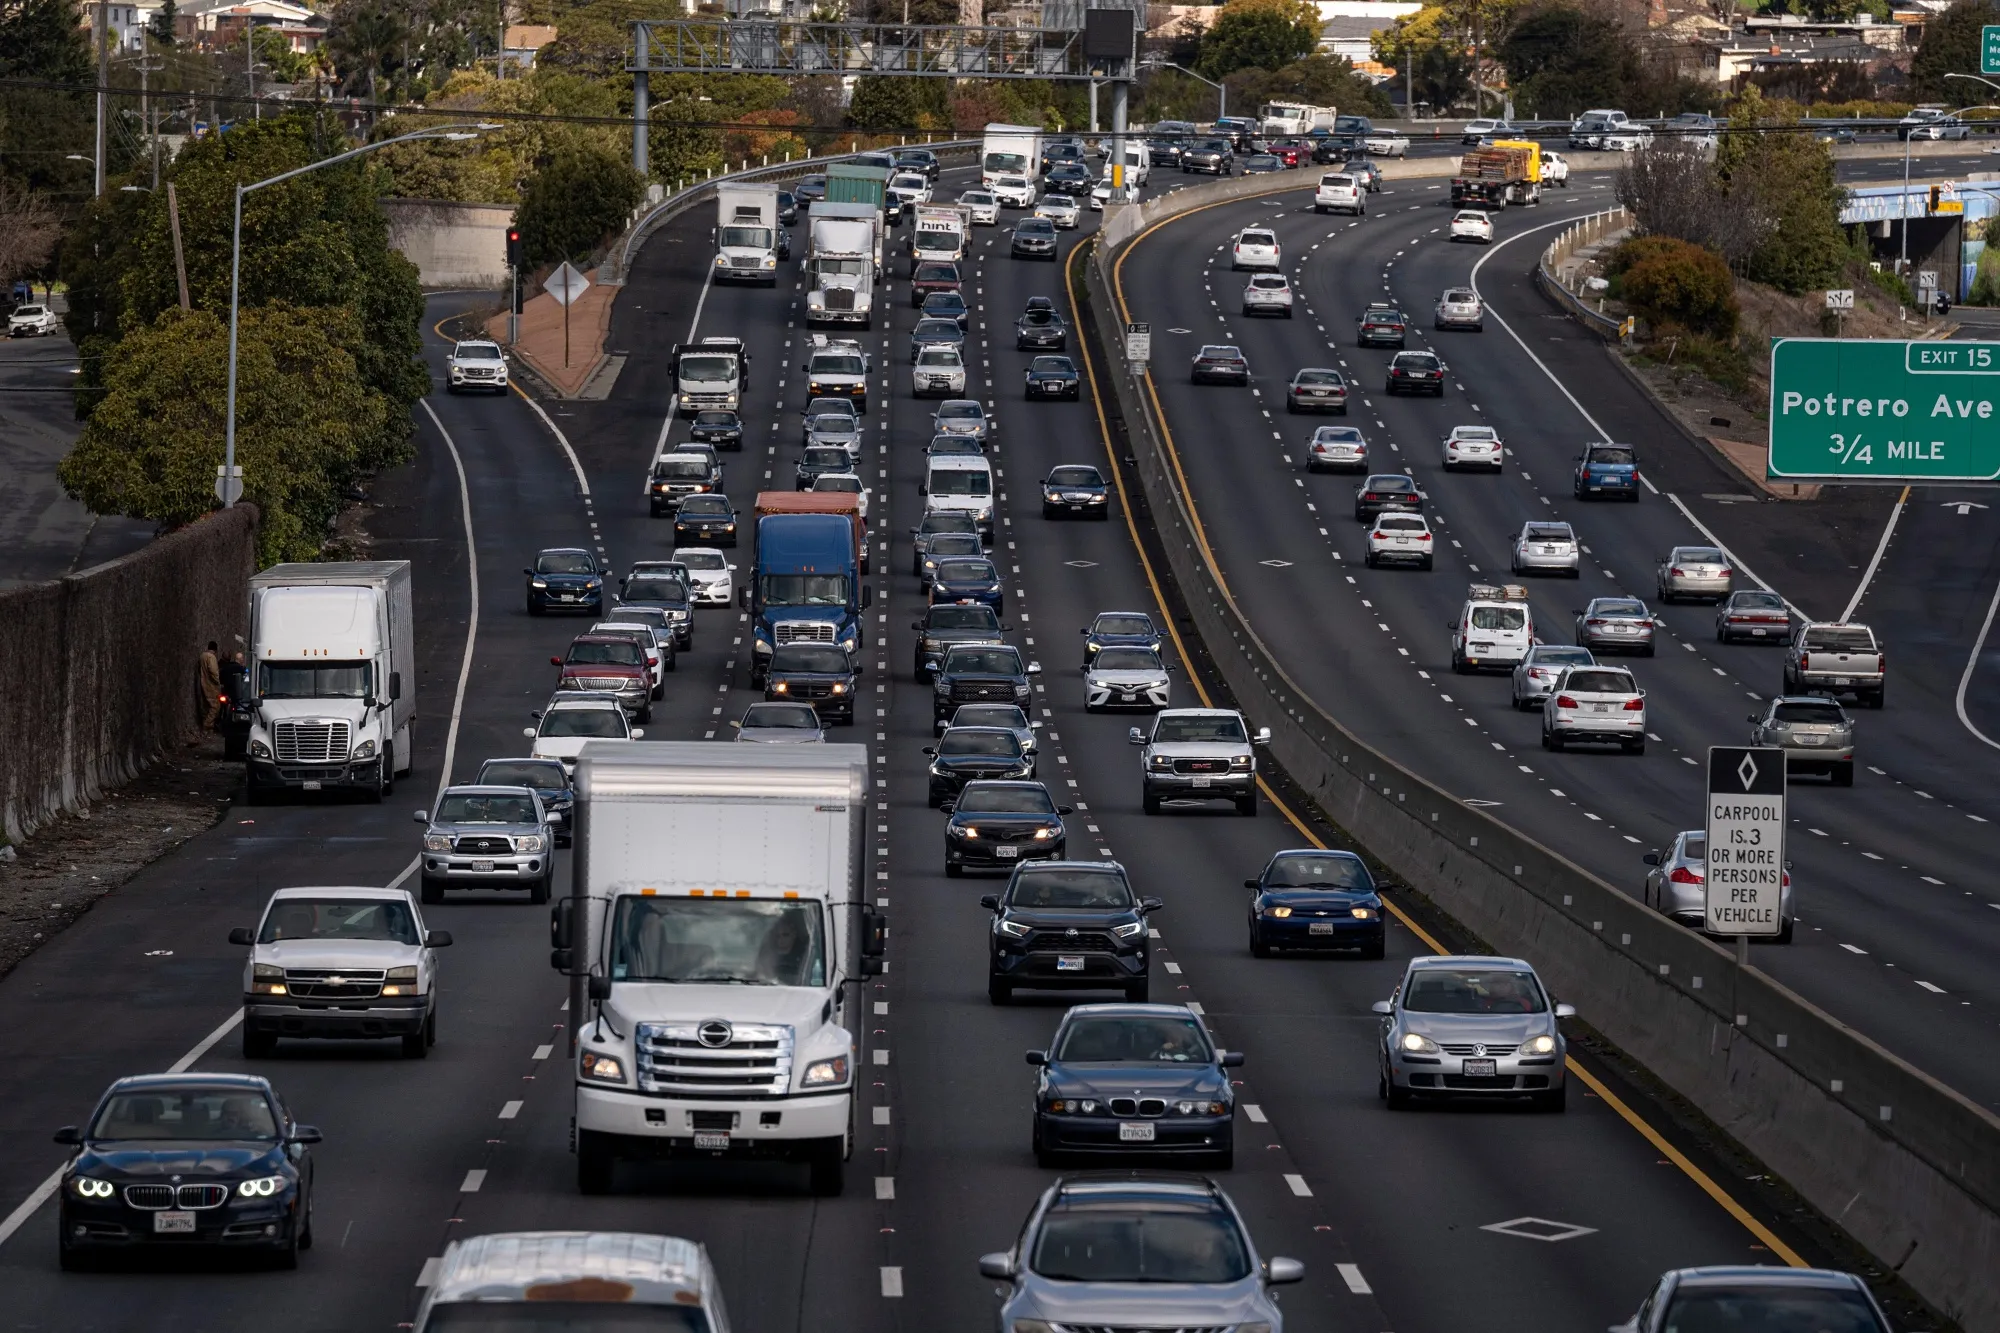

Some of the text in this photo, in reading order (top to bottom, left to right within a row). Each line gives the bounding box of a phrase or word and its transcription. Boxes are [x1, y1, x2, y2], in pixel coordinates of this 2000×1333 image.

[921, 221, 952, 231] hint
[1921, 348, 1992, 367] EXIT 15
[1782, 391, 1993, 418] Potrero Ave
[1828, 433, 1945, 465] 3/4 MILE
[1714, 805, 1780, 821] CARPOOL
[1749, 828, 1761, 845] 3
[1711, 848, 1775, 864] OR MORE
[1712, 868, 1777, 884] PERSONS
[1731, 888, 1757, 903] PER
[1714, 907, 1772, 923] VEHICLE
